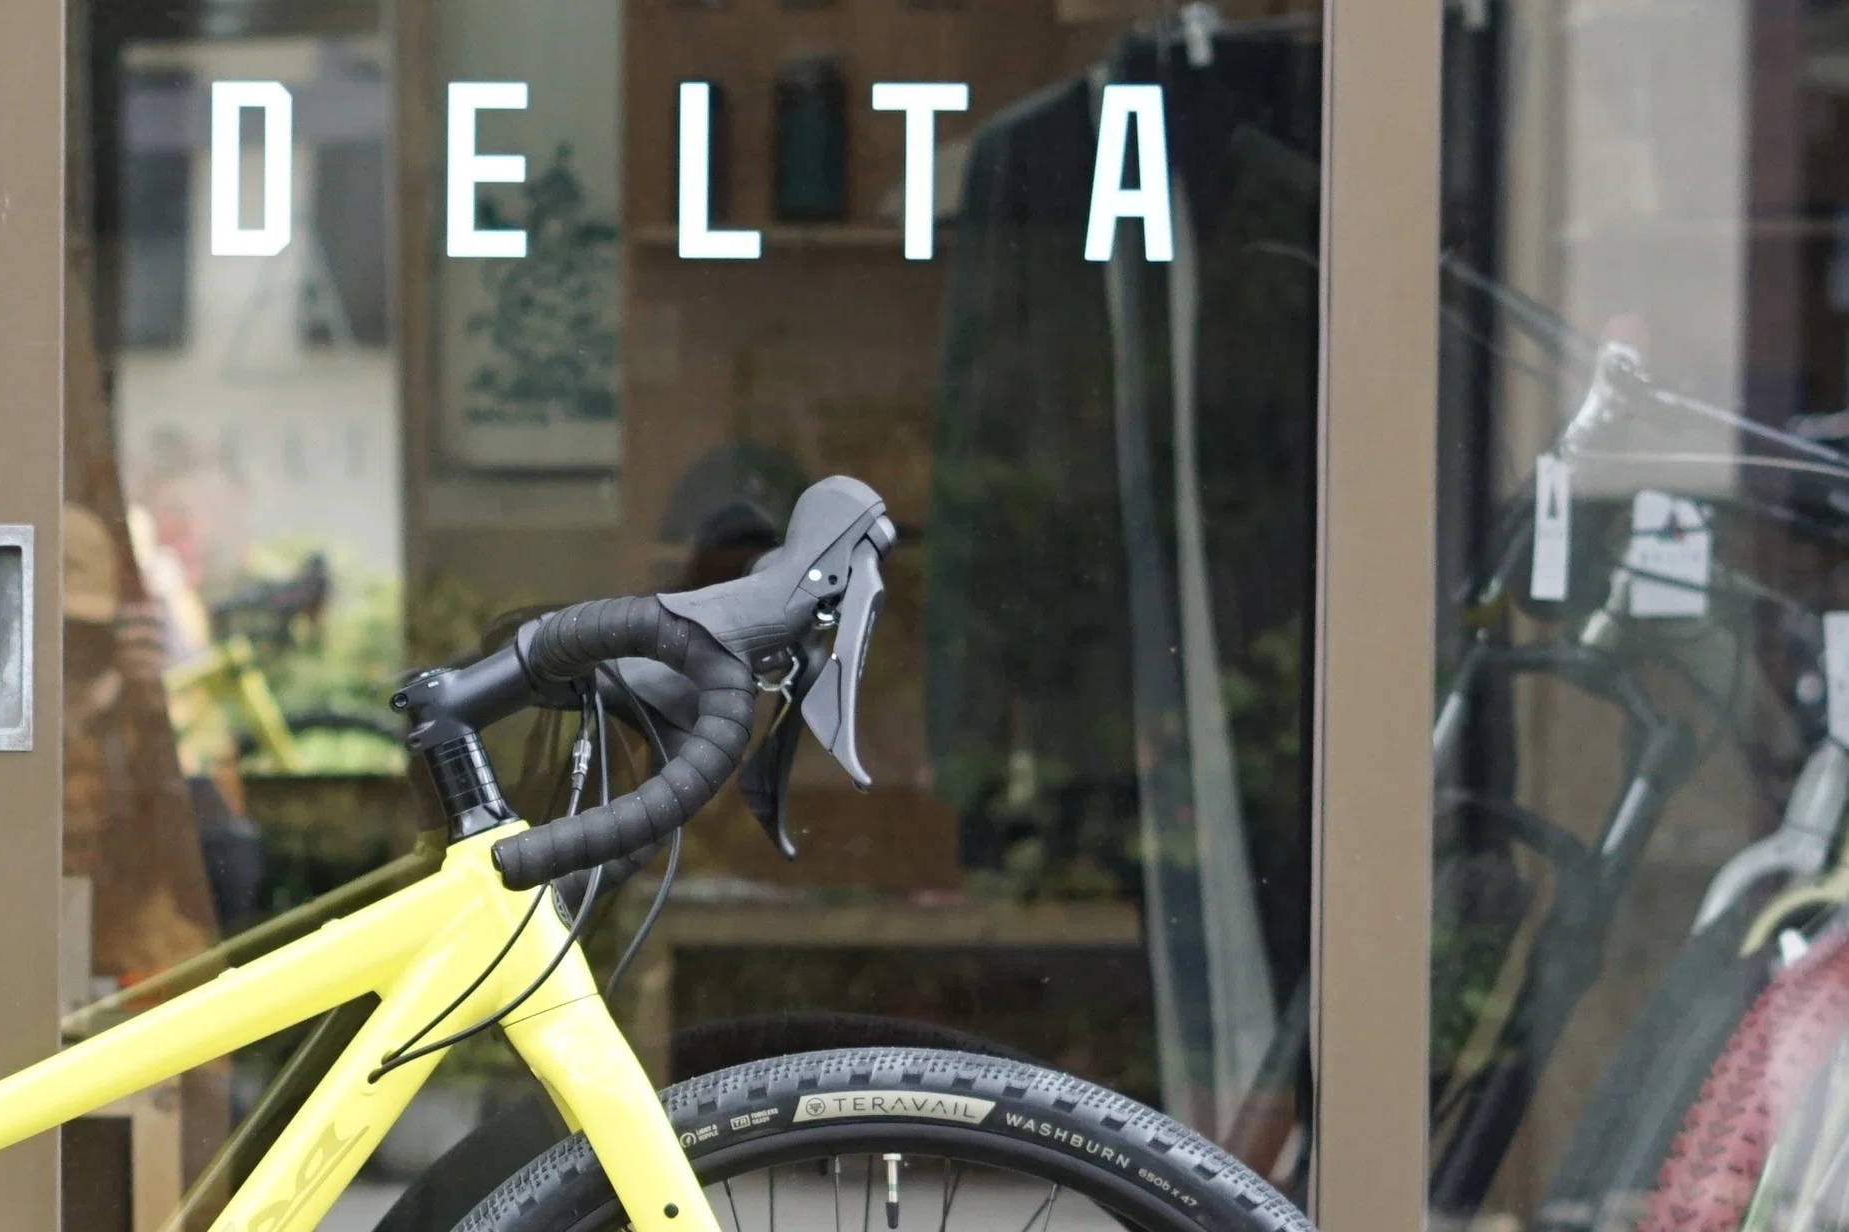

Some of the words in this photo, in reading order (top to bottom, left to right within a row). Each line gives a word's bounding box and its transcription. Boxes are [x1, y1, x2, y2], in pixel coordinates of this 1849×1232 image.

[211, 81, 1174, 262] DELTA
[833, 1097, 977, 1119] TERAVAIL
[1006, 1112, 1130, 1169] WASHBURN
[1138, 1168, 1170, 1191] 650b
[1180, 1194, 1198, 1207] 47
